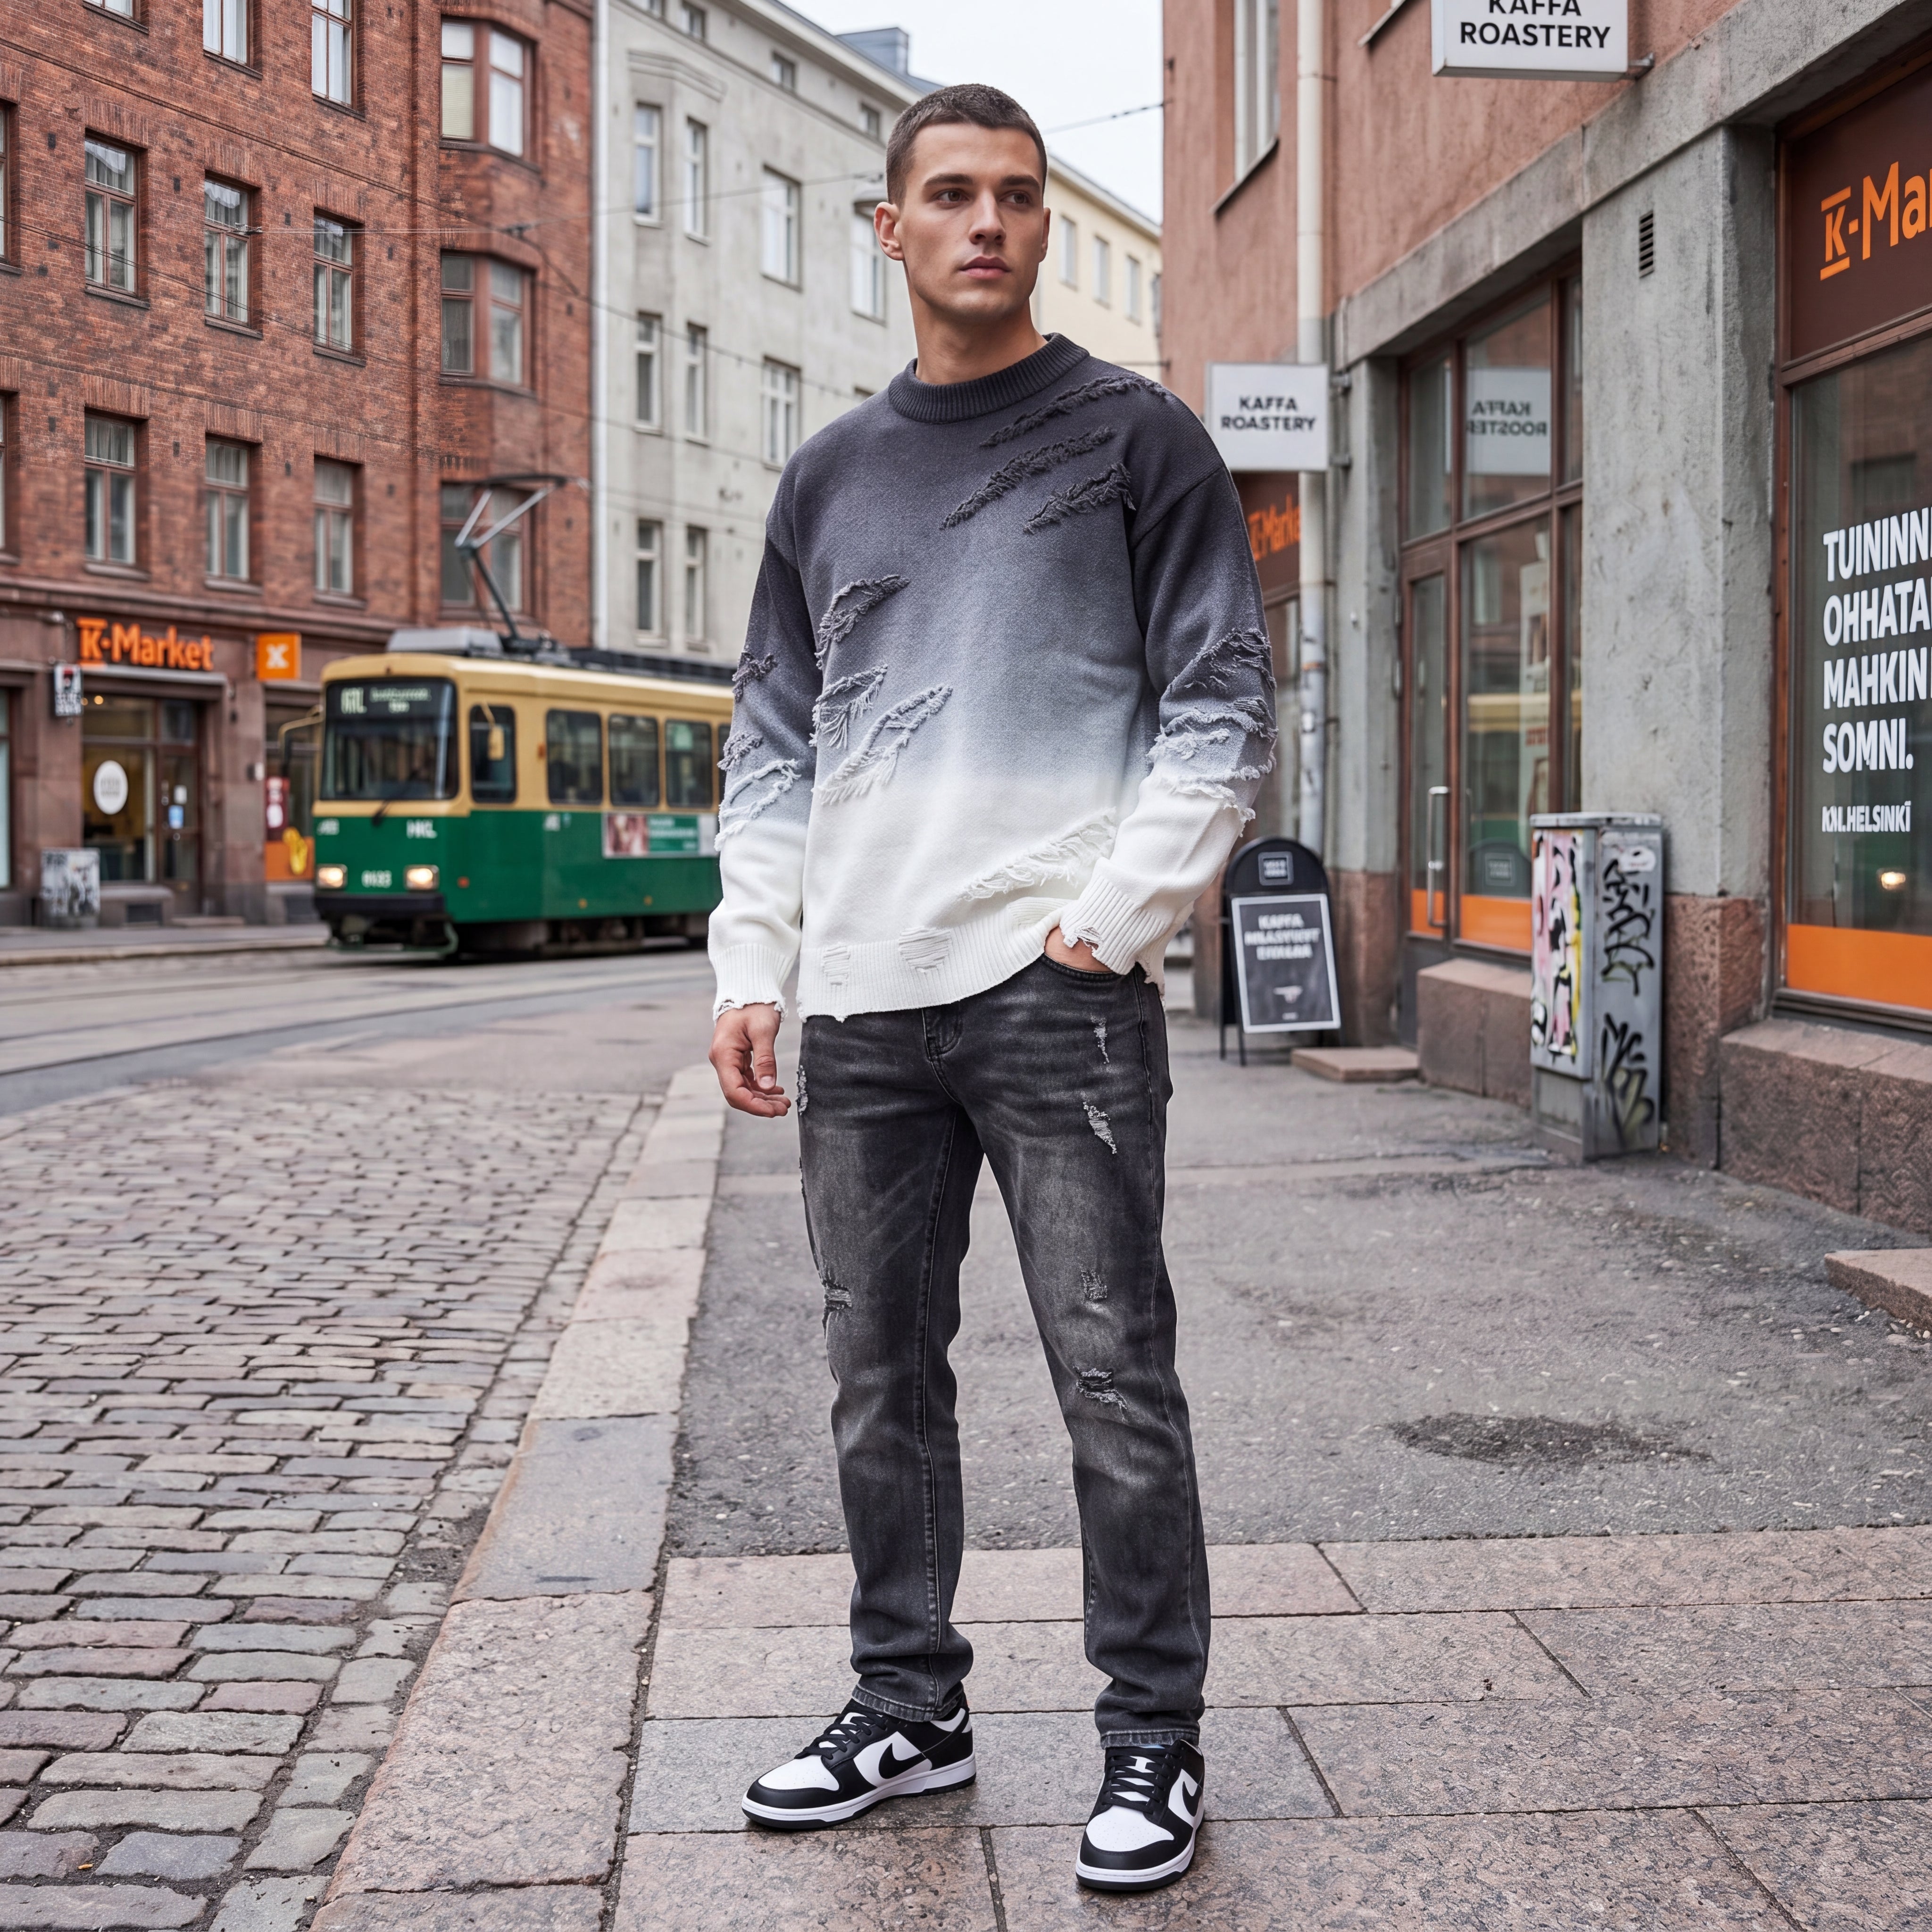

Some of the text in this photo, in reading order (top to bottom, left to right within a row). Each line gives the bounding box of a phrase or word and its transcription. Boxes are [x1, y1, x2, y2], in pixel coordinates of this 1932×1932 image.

[1460, 22, 1611, 48] ROASTERY
[1489, 0, 1582, 16] KAFFA
[1820, 161, 1932, 281] K-Ma
[1221, 416, 1316, 431] ROASTERY
[1240, 396, 1297, 410] KAFFA
[1823, 507, 1932, 582] TUININN
[1823, 576, 1932, 646] OHHATA
[1824, 647, 1932, 709] MAHKIN
[1823, 718, 1914, 774] SOMNI.
